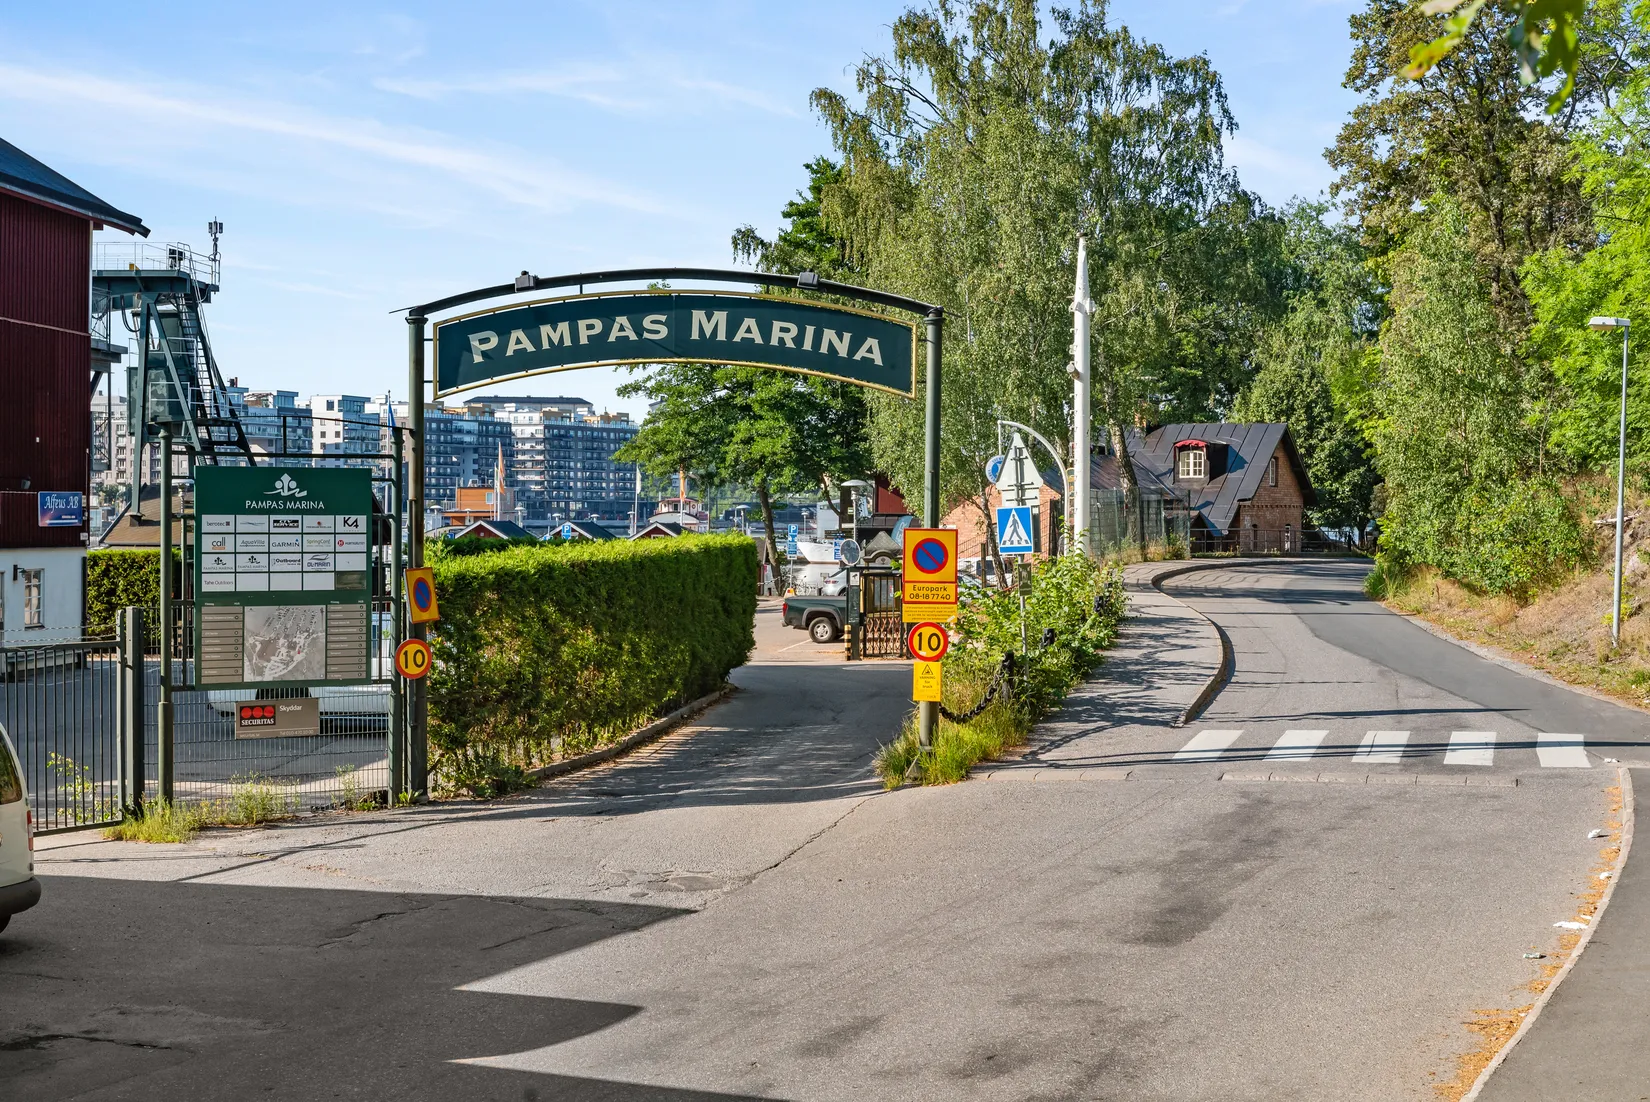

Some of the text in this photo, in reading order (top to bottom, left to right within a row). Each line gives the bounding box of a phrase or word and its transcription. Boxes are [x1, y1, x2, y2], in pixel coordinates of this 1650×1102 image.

[468, 309, 884, 366] PAMPAS MARINA
[67, 496, 79, 508] AB
[245, 500, 325, 510] PAMPAS MARINA
[343, 516, 359, 528] K4
[212, 536, 226, 546] call
[918, 632, 941, 652] 10
[403, 648, 426, 669] 10
[280, 704, 302, 712] Skyddar
